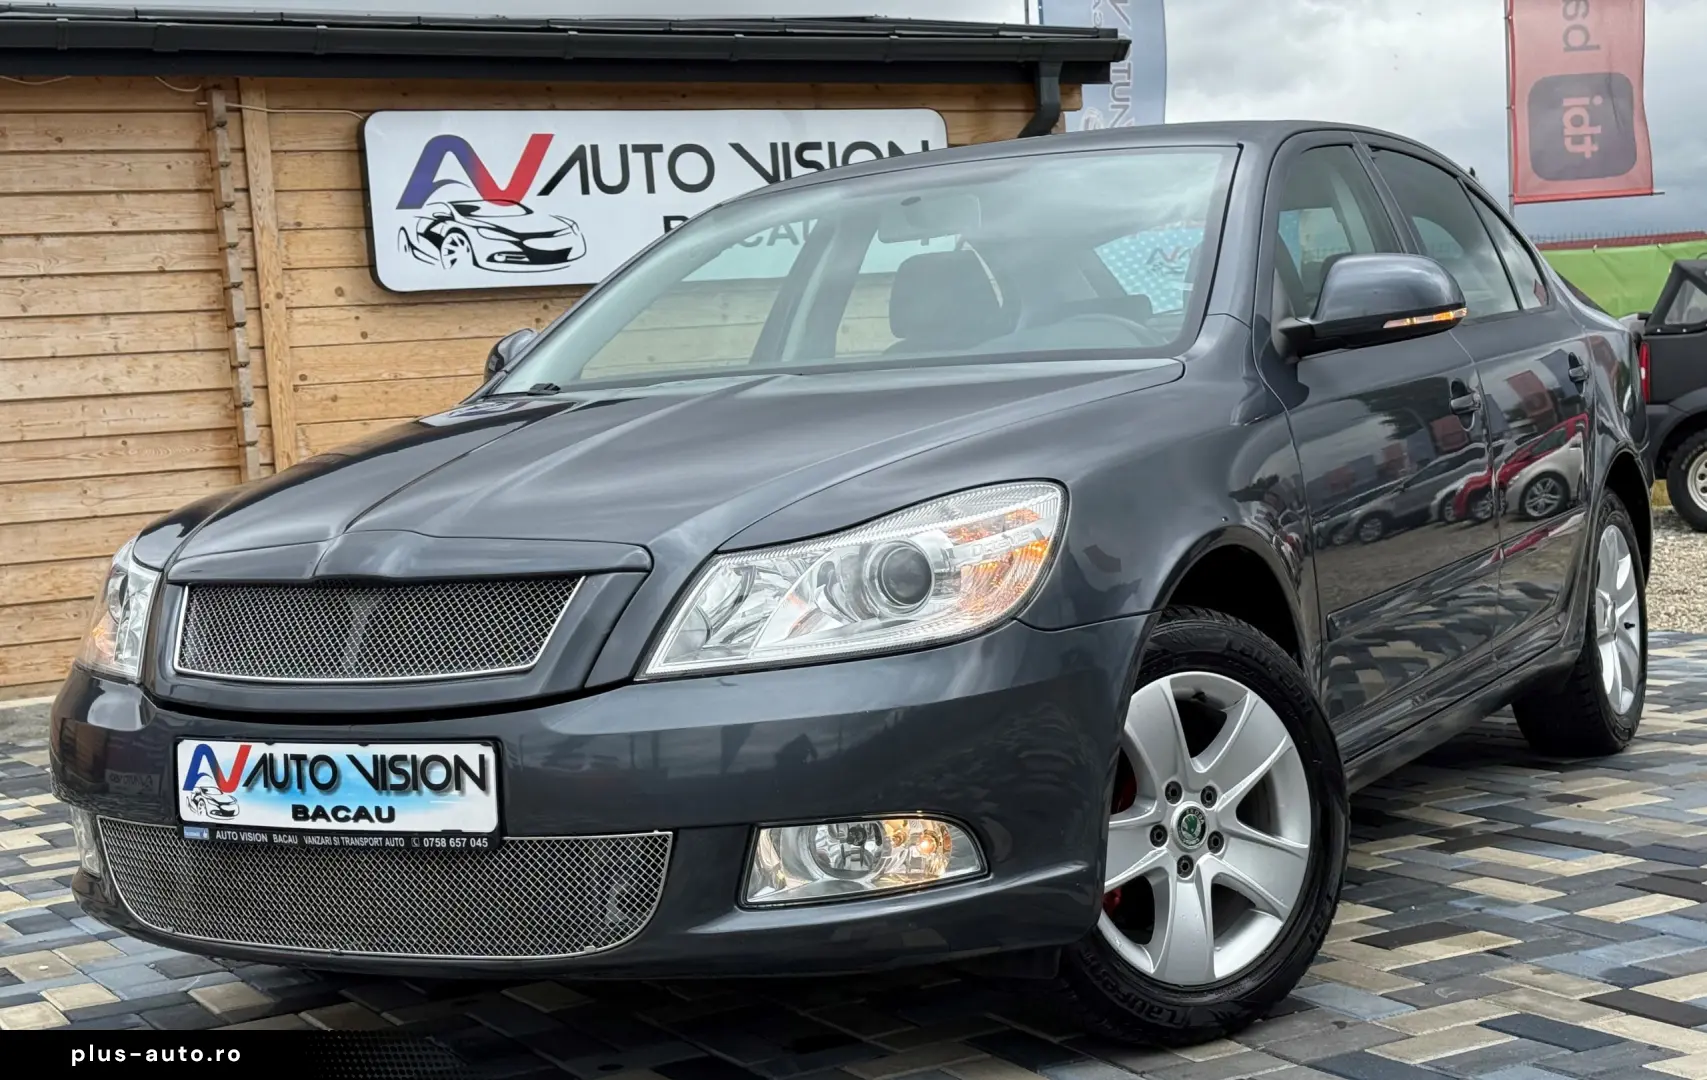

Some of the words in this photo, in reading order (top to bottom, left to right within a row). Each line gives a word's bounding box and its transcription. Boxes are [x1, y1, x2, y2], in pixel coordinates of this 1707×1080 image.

[537, 142, 715, 197] AUTO
[242, 752, 338, 791] AUTO
[346, 753, 488, 793] VISION
[291, 803, 396, 824] BACAU
[216, 830, 238, 841] AUTO
[240, 832, 268, 843] VISION
[273, 834, 298, 844] BACAU
[303, 835, 332, 846] VANZARI
[341, 836, 383, 847] TRANSPORT
[385, 837, 405, 847] AUTO
[423, 838, 446, 848] 0758
[450, 838, 466, 848] 657
[470, 838, 488, 848] 045
